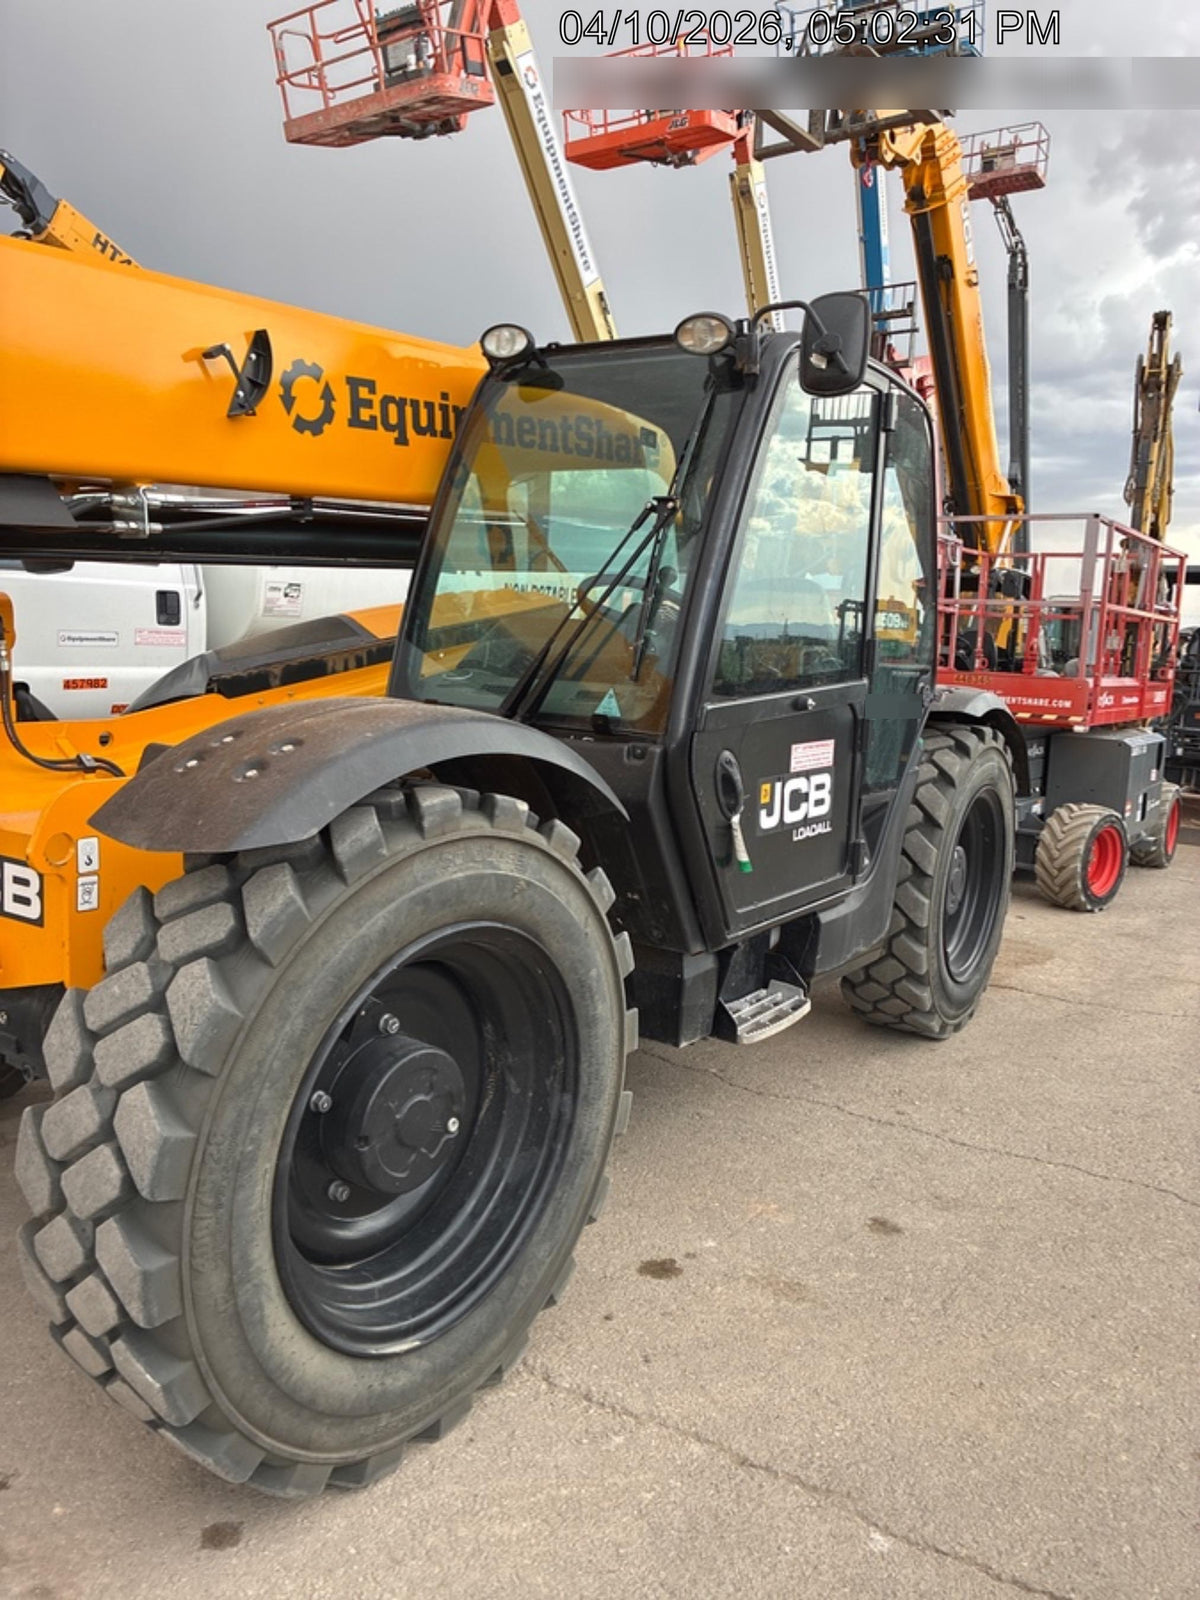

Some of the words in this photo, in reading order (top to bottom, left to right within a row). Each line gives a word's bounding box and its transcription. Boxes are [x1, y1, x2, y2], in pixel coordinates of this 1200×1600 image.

[532, 91, 592, 273] EquipmentShare
[759, 772, 832, 830] JCB
[792, 820, 833, 842] LOADALL
